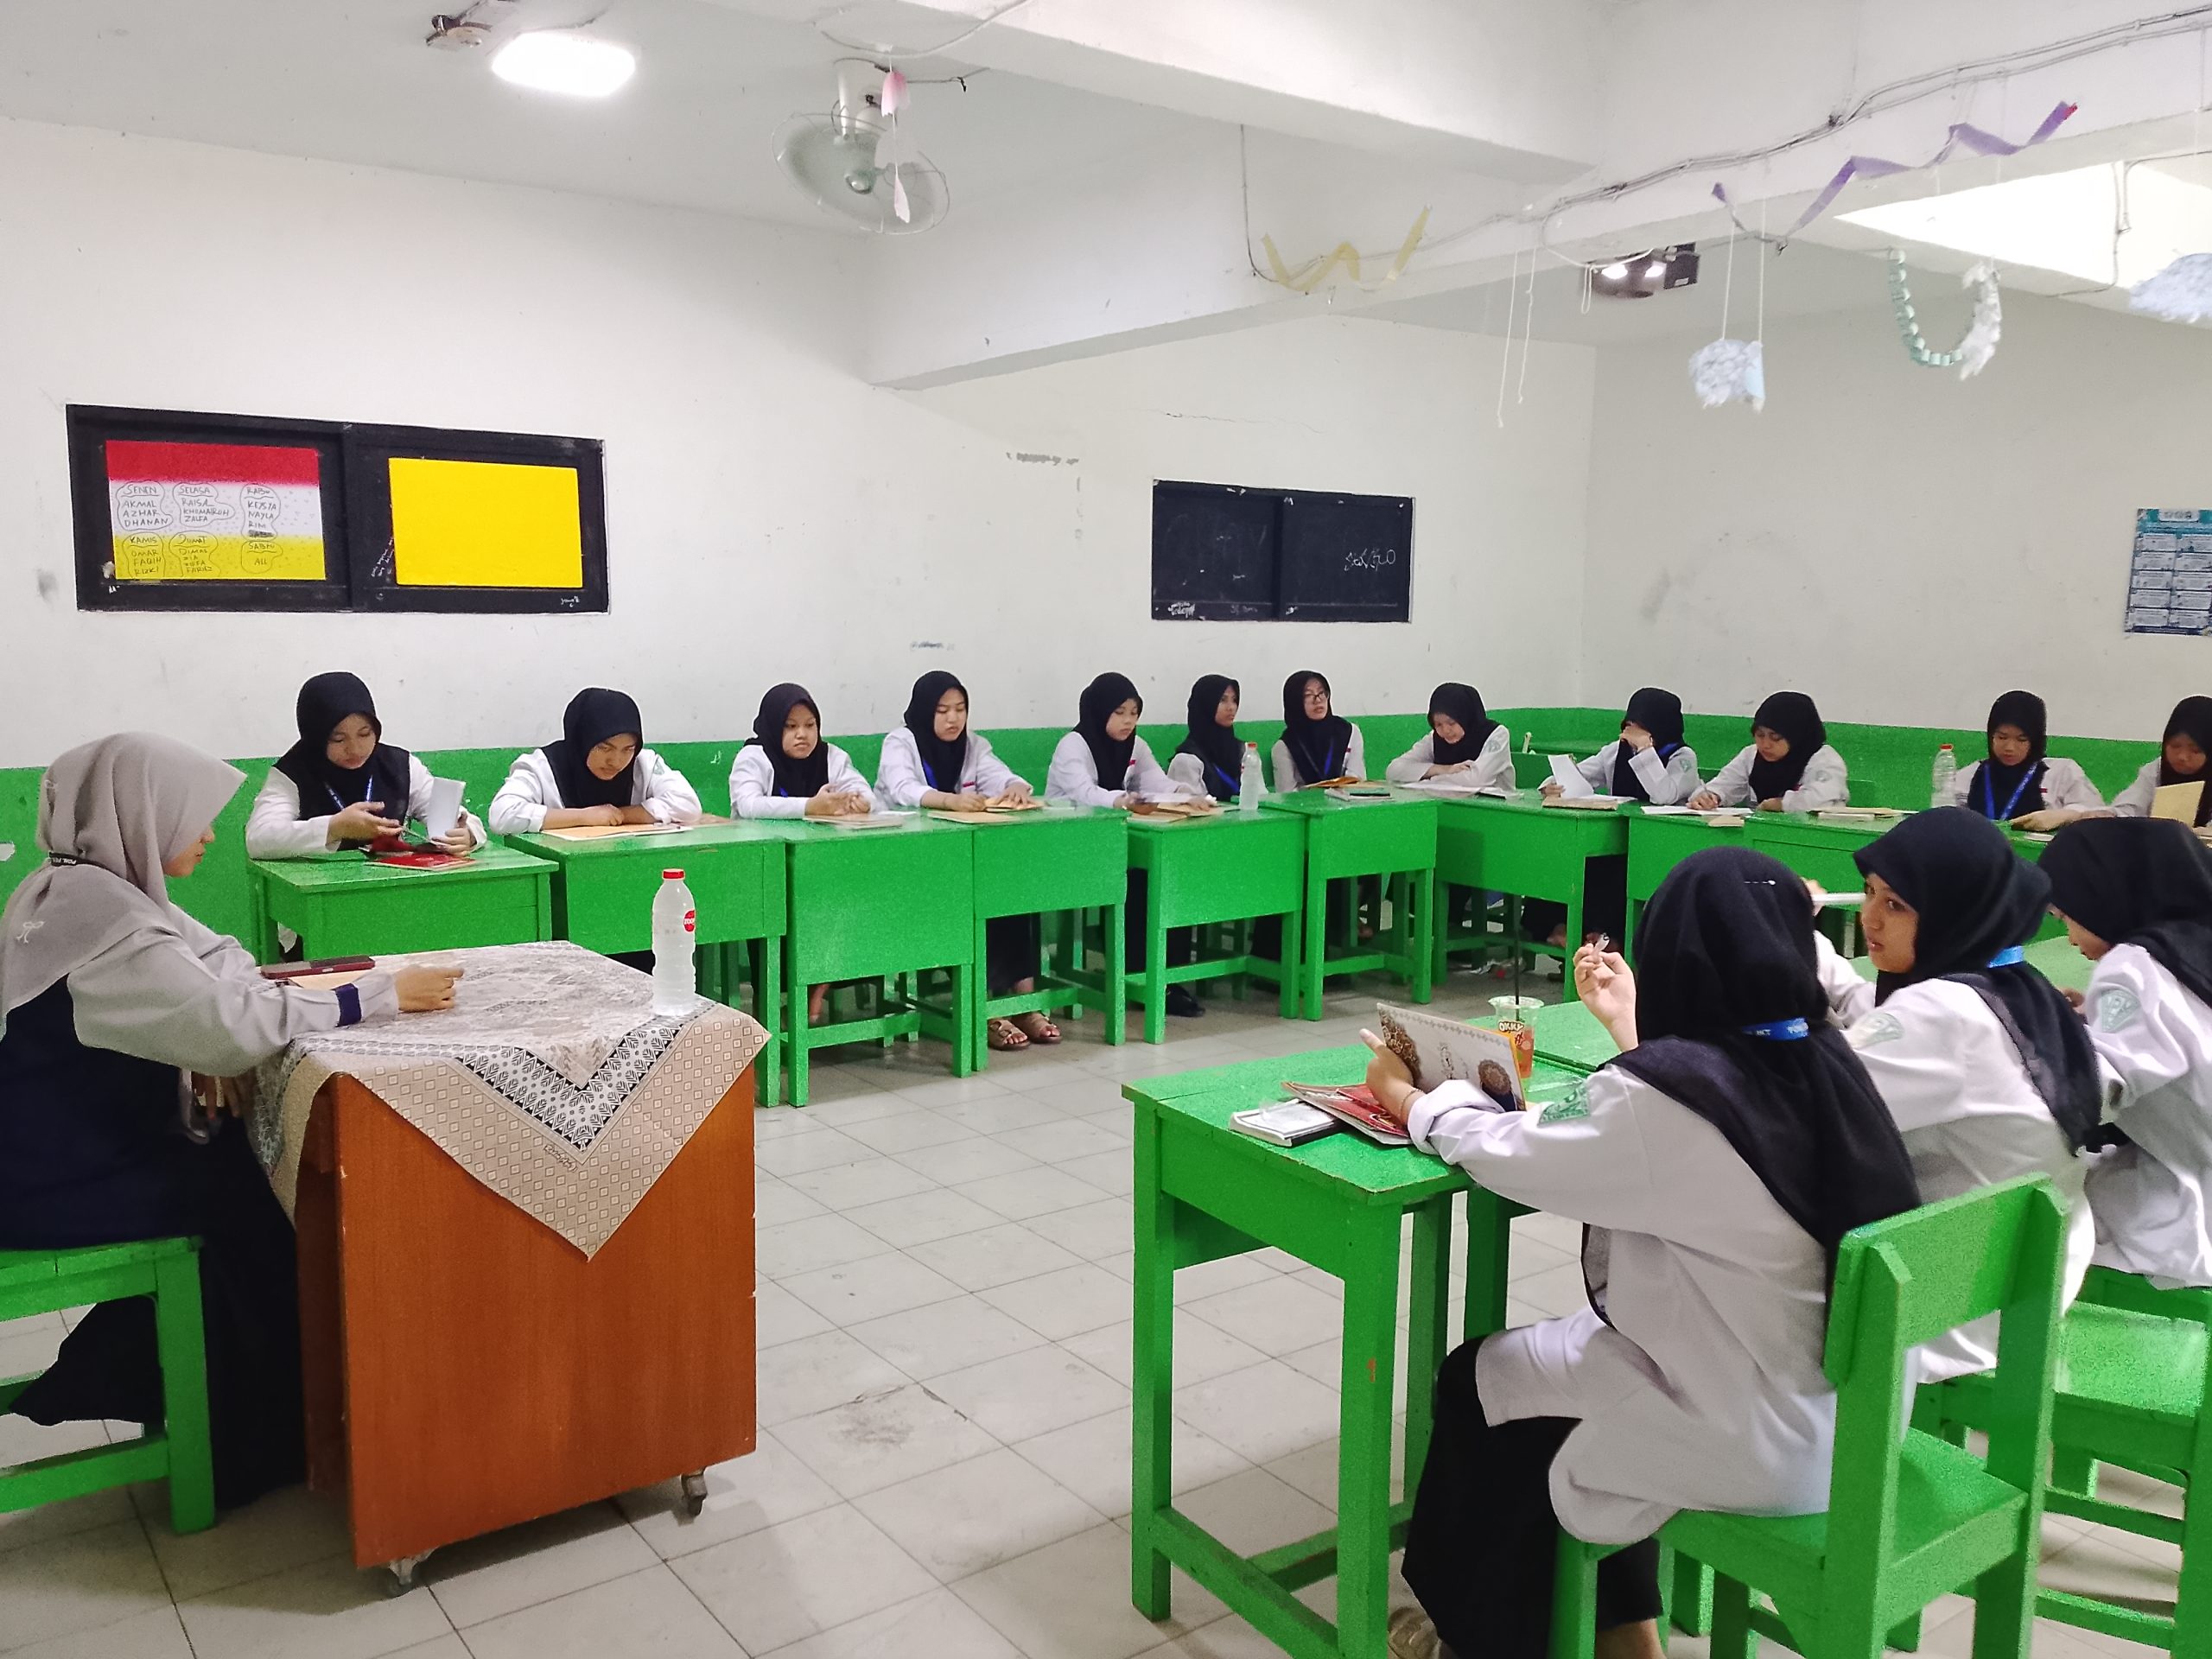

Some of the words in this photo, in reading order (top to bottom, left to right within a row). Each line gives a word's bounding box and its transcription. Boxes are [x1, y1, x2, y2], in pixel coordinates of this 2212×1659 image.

[123, 484, 157, 495] SENEN
[178, 485, 211, 494] SELASA
[181, 497, 214, 507] RAISA
[123, 509, 161, 518] AZHAR
[248, 511, 275, 520] NAYLA
[130, 536, 157, 544] KAMIS
[1498, 1020, 1524, 1032] OKKY
